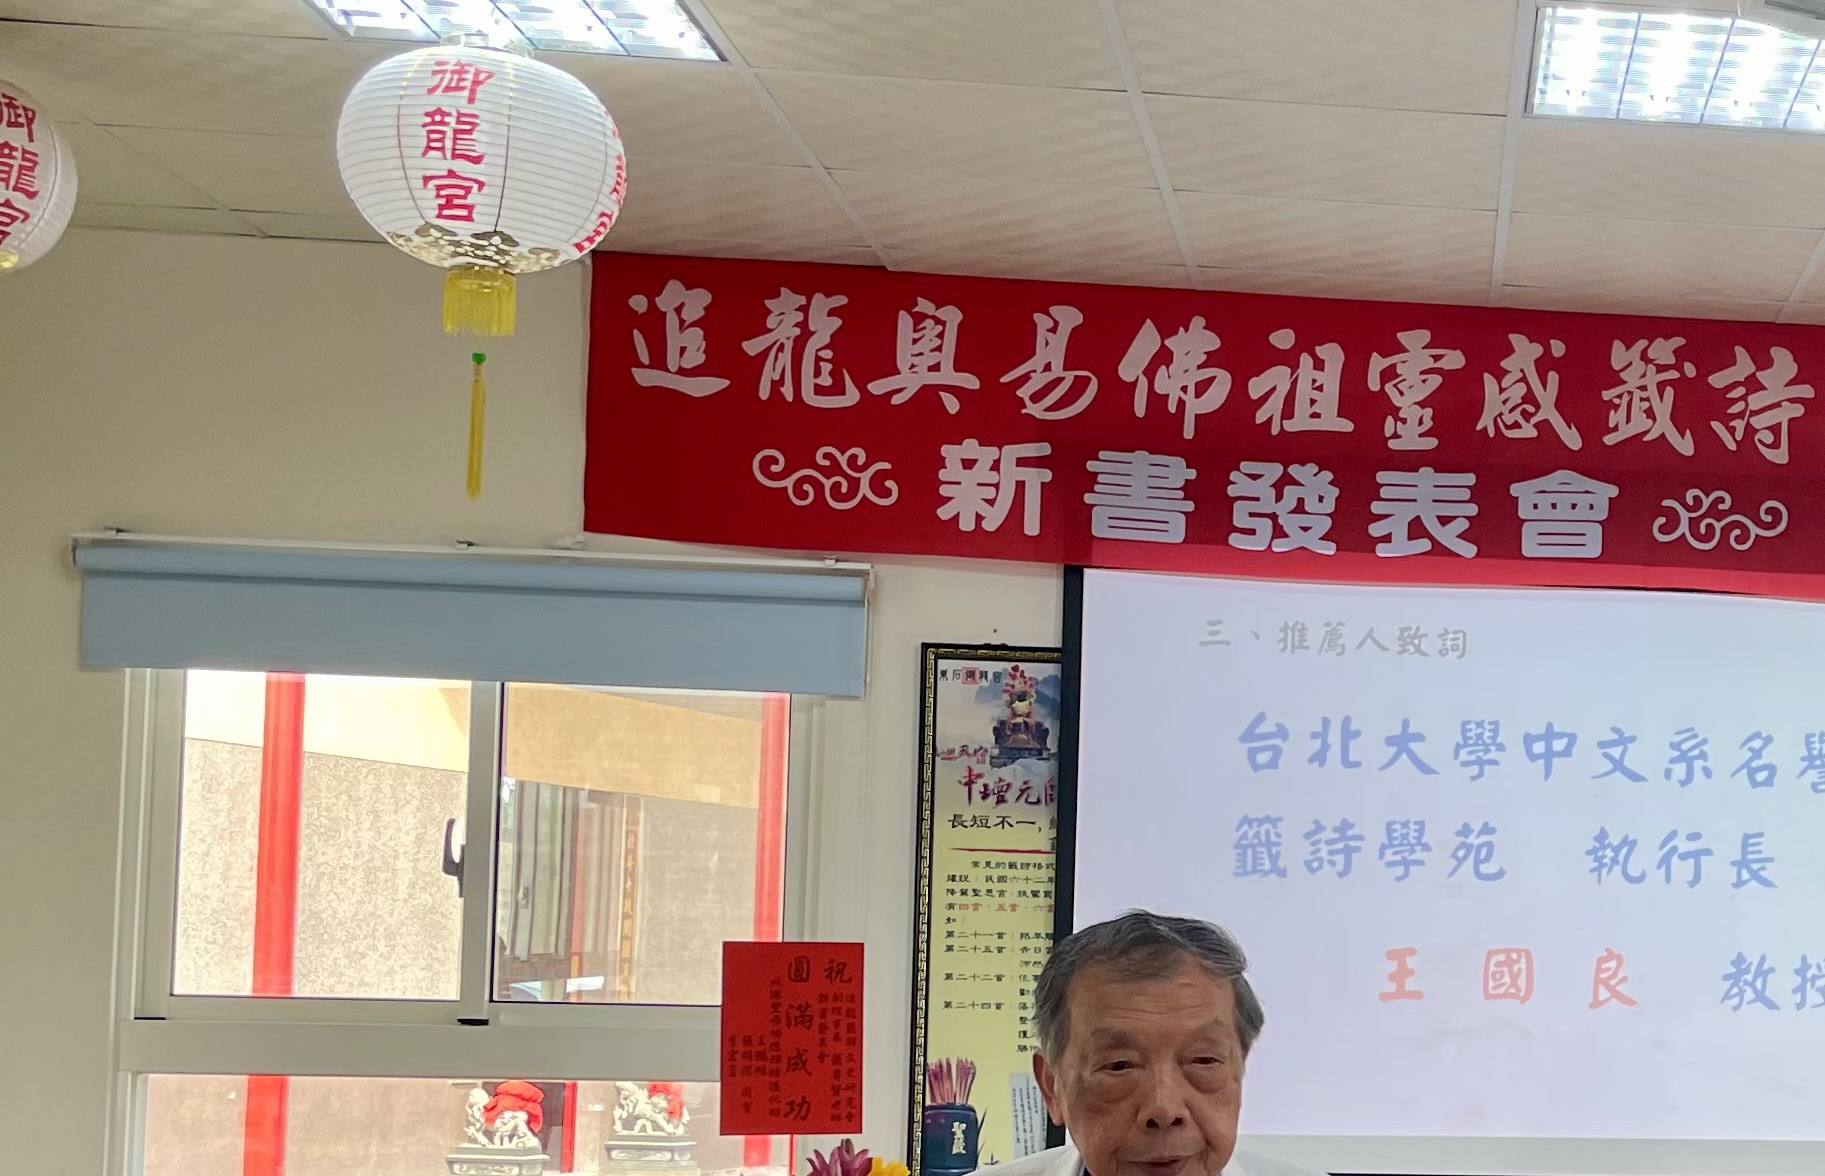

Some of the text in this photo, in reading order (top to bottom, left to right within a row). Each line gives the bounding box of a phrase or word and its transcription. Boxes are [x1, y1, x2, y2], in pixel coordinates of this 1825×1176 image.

[421, 58, 497, 224] 御龍宮
[937, 437, 1619, 560] 新書發表會
[1231, 812, 1778, 890] 籤詩學苑 執行長
[823, 957, 853, 985] 祝
[1377, 945, 1642, 1011] 王國良
[783, 954, 816, 1123] 圓滿成功
